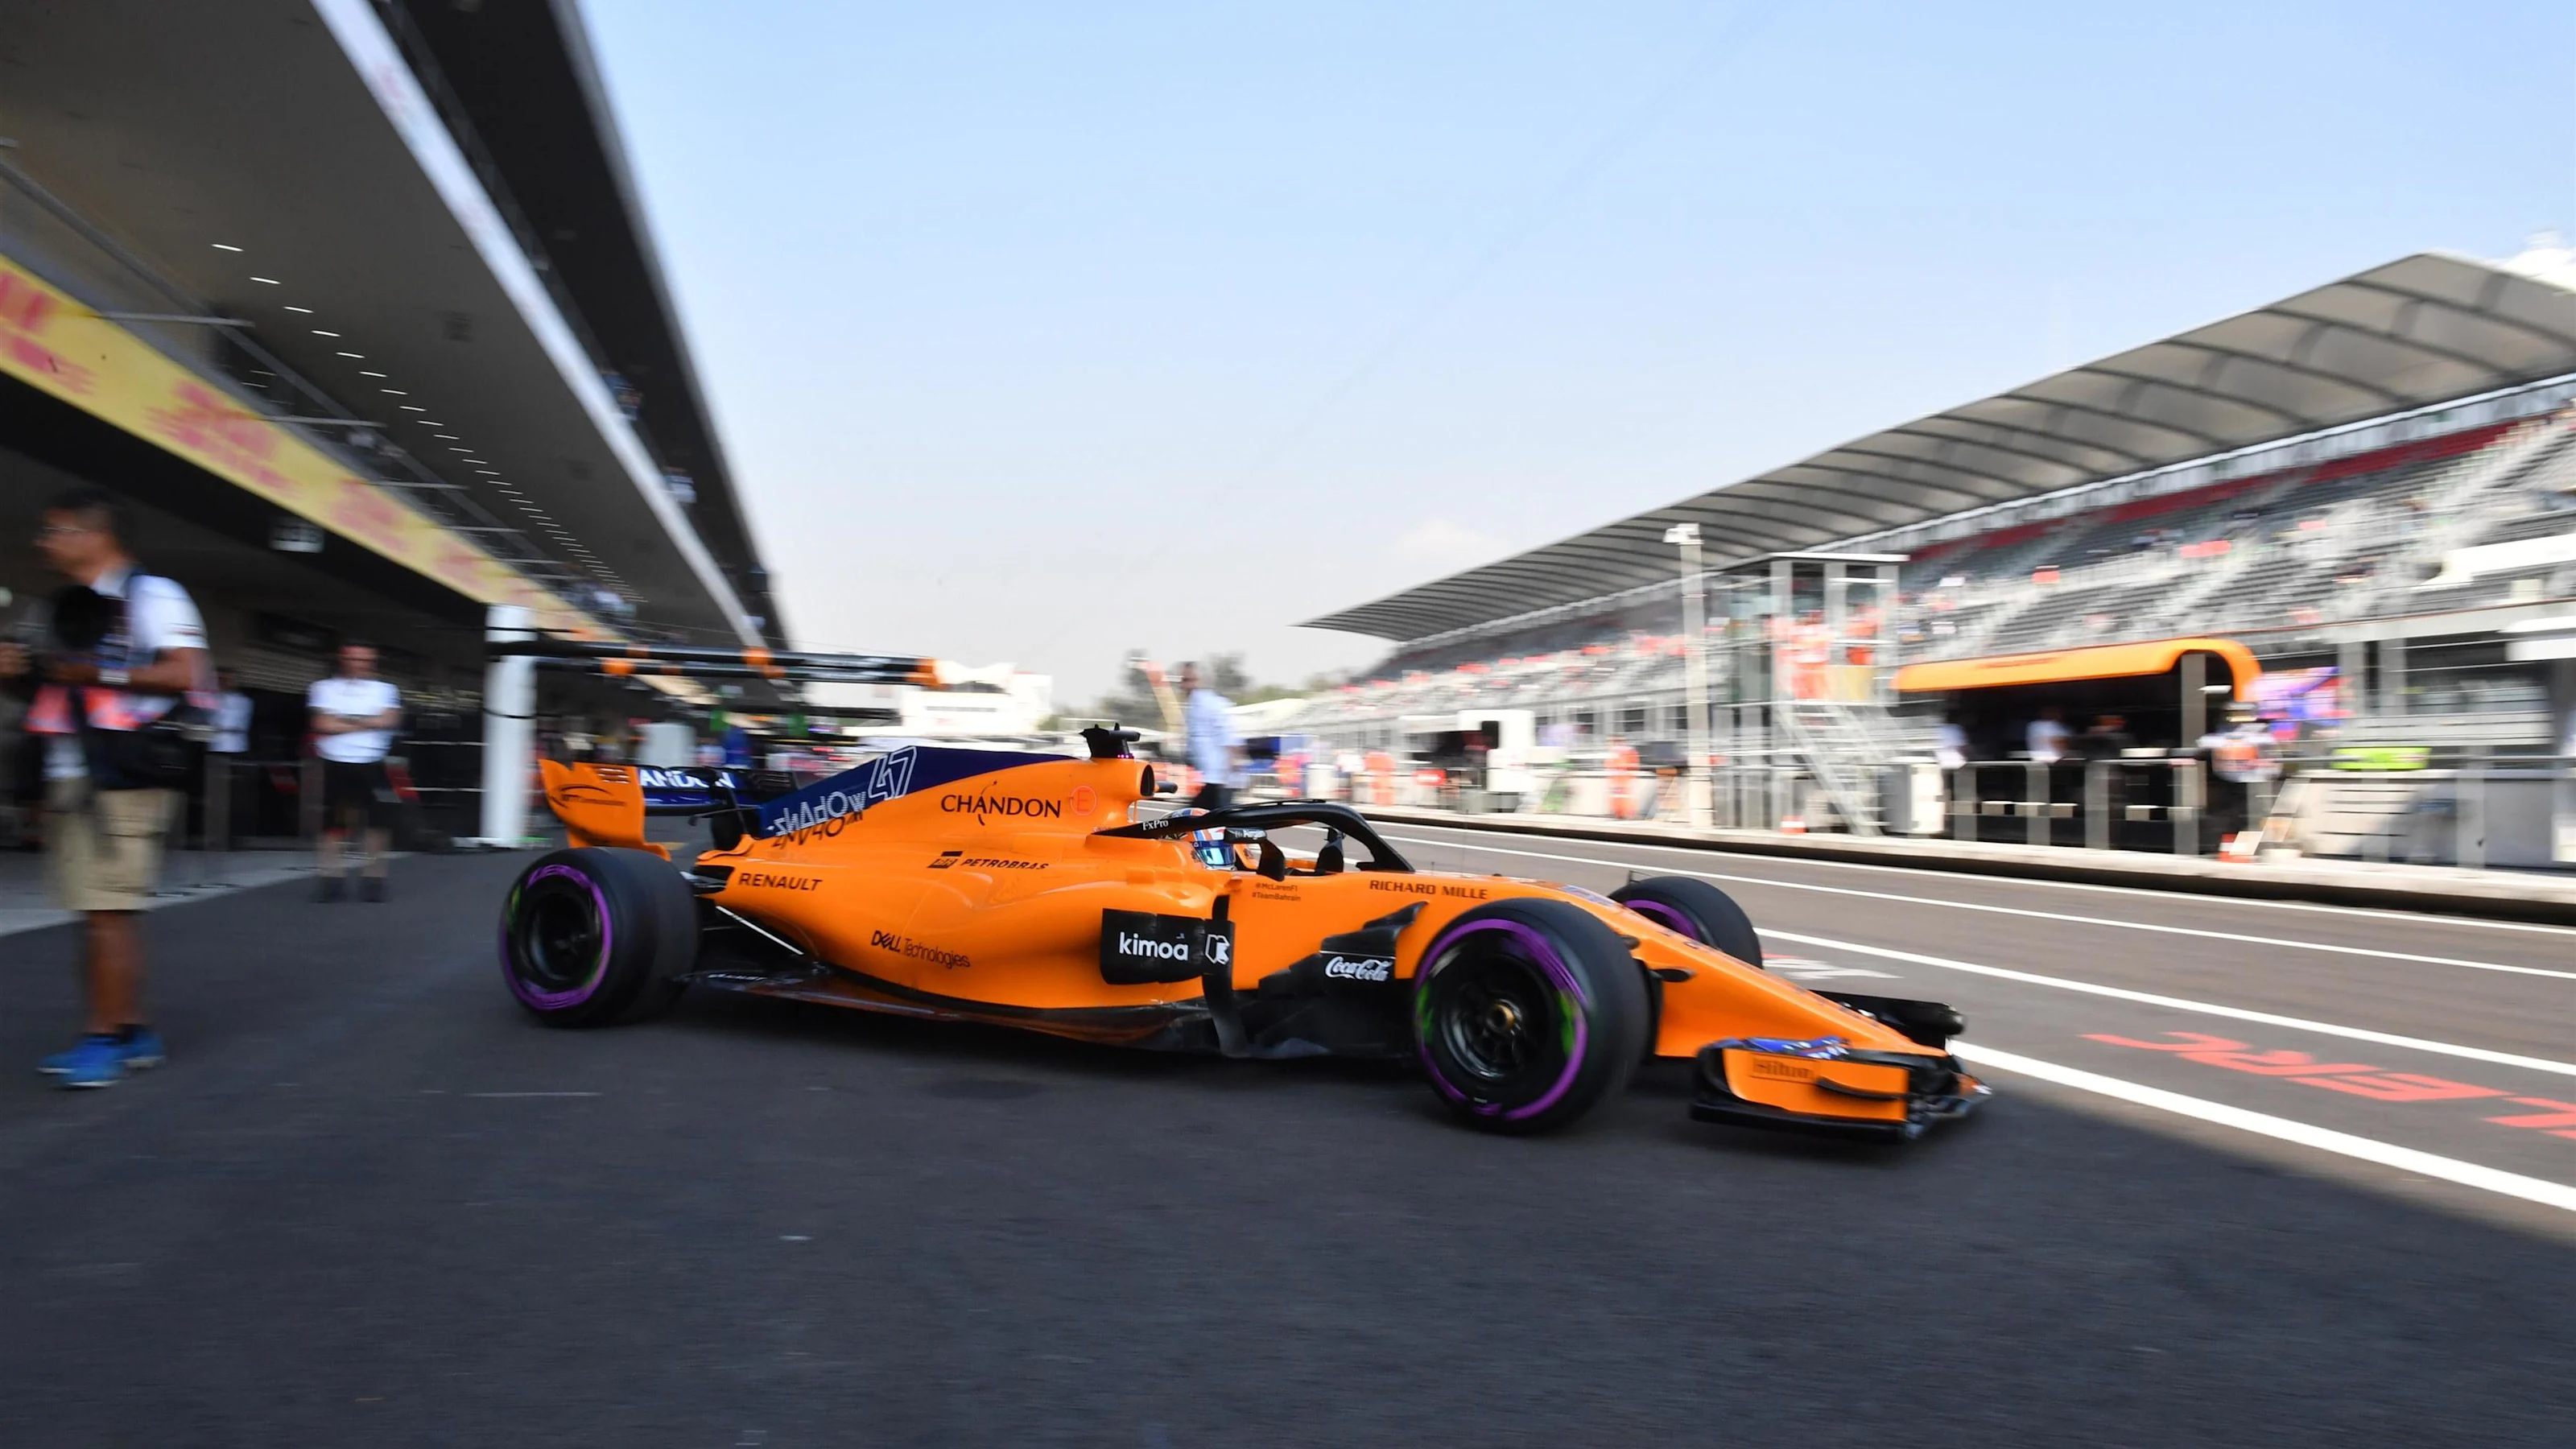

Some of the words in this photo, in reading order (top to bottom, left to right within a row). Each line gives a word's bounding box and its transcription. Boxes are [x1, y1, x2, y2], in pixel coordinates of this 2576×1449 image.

[868, 745, 917, 801] 47
[941, 788, 1061, 820] CHANDON
[1142, 819, 1169, 831] FxPro
[960, 858, 1049, 869] PETROBRAS
[738, 873, 823, 891] RENAULT
[1369, 880, 1435, 895] RICHARD
[1441, 886, 1488, 899] MILLE
[871, 931, 902, 952] DELL
[904, 938, 971, 969] Technologies
[1119, 931, 1189, 961] kimoa
